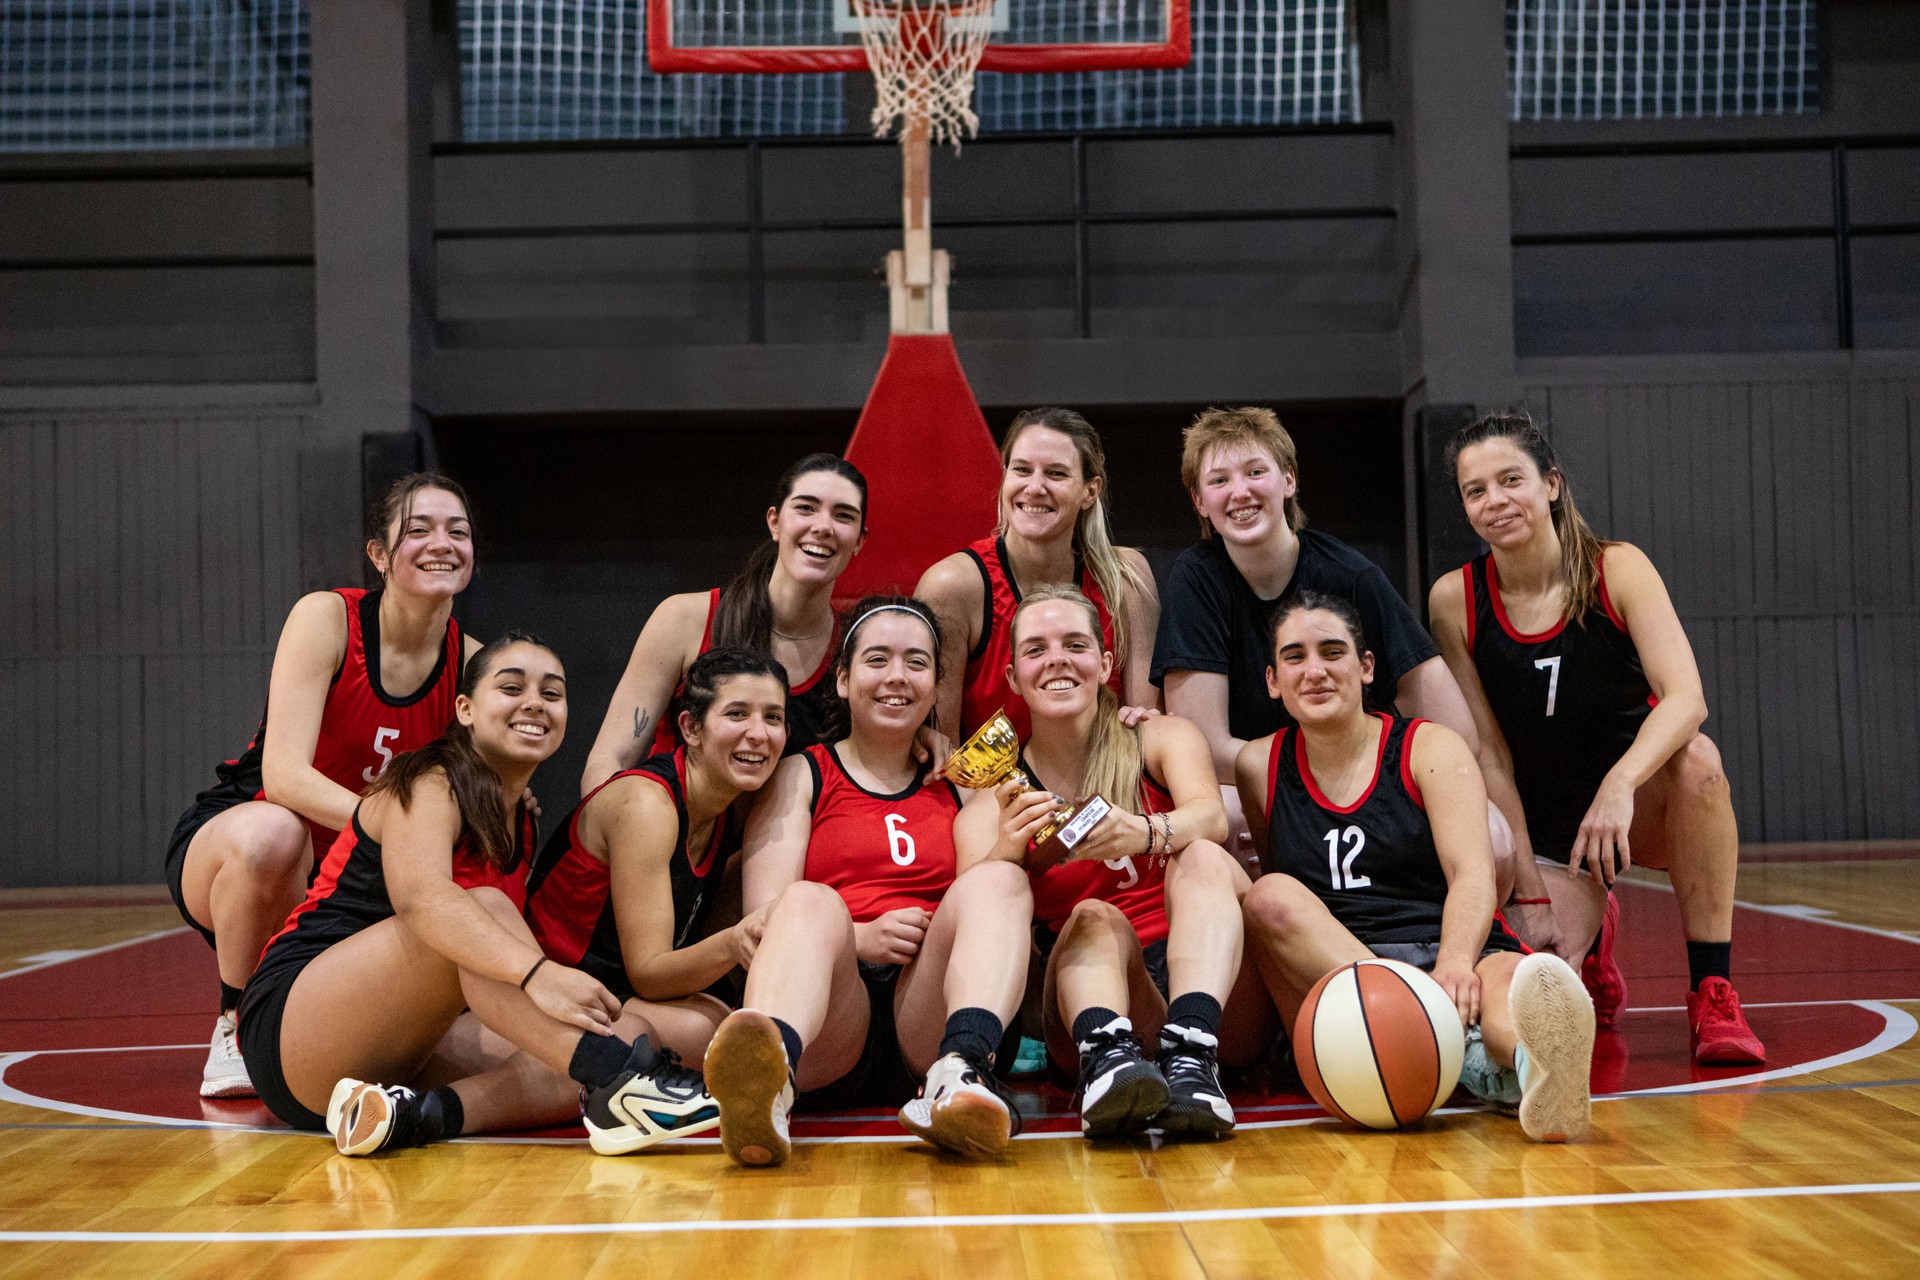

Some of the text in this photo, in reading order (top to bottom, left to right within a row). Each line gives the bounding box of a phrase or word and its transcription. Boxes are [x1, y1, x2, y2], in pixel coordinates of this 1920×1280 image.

[1534, 656, 1561, 717] 7
[362, 726, 400, 783] 5
[884, 813, 916, 866] 6
[1323, 825, 1371, 890] 12
